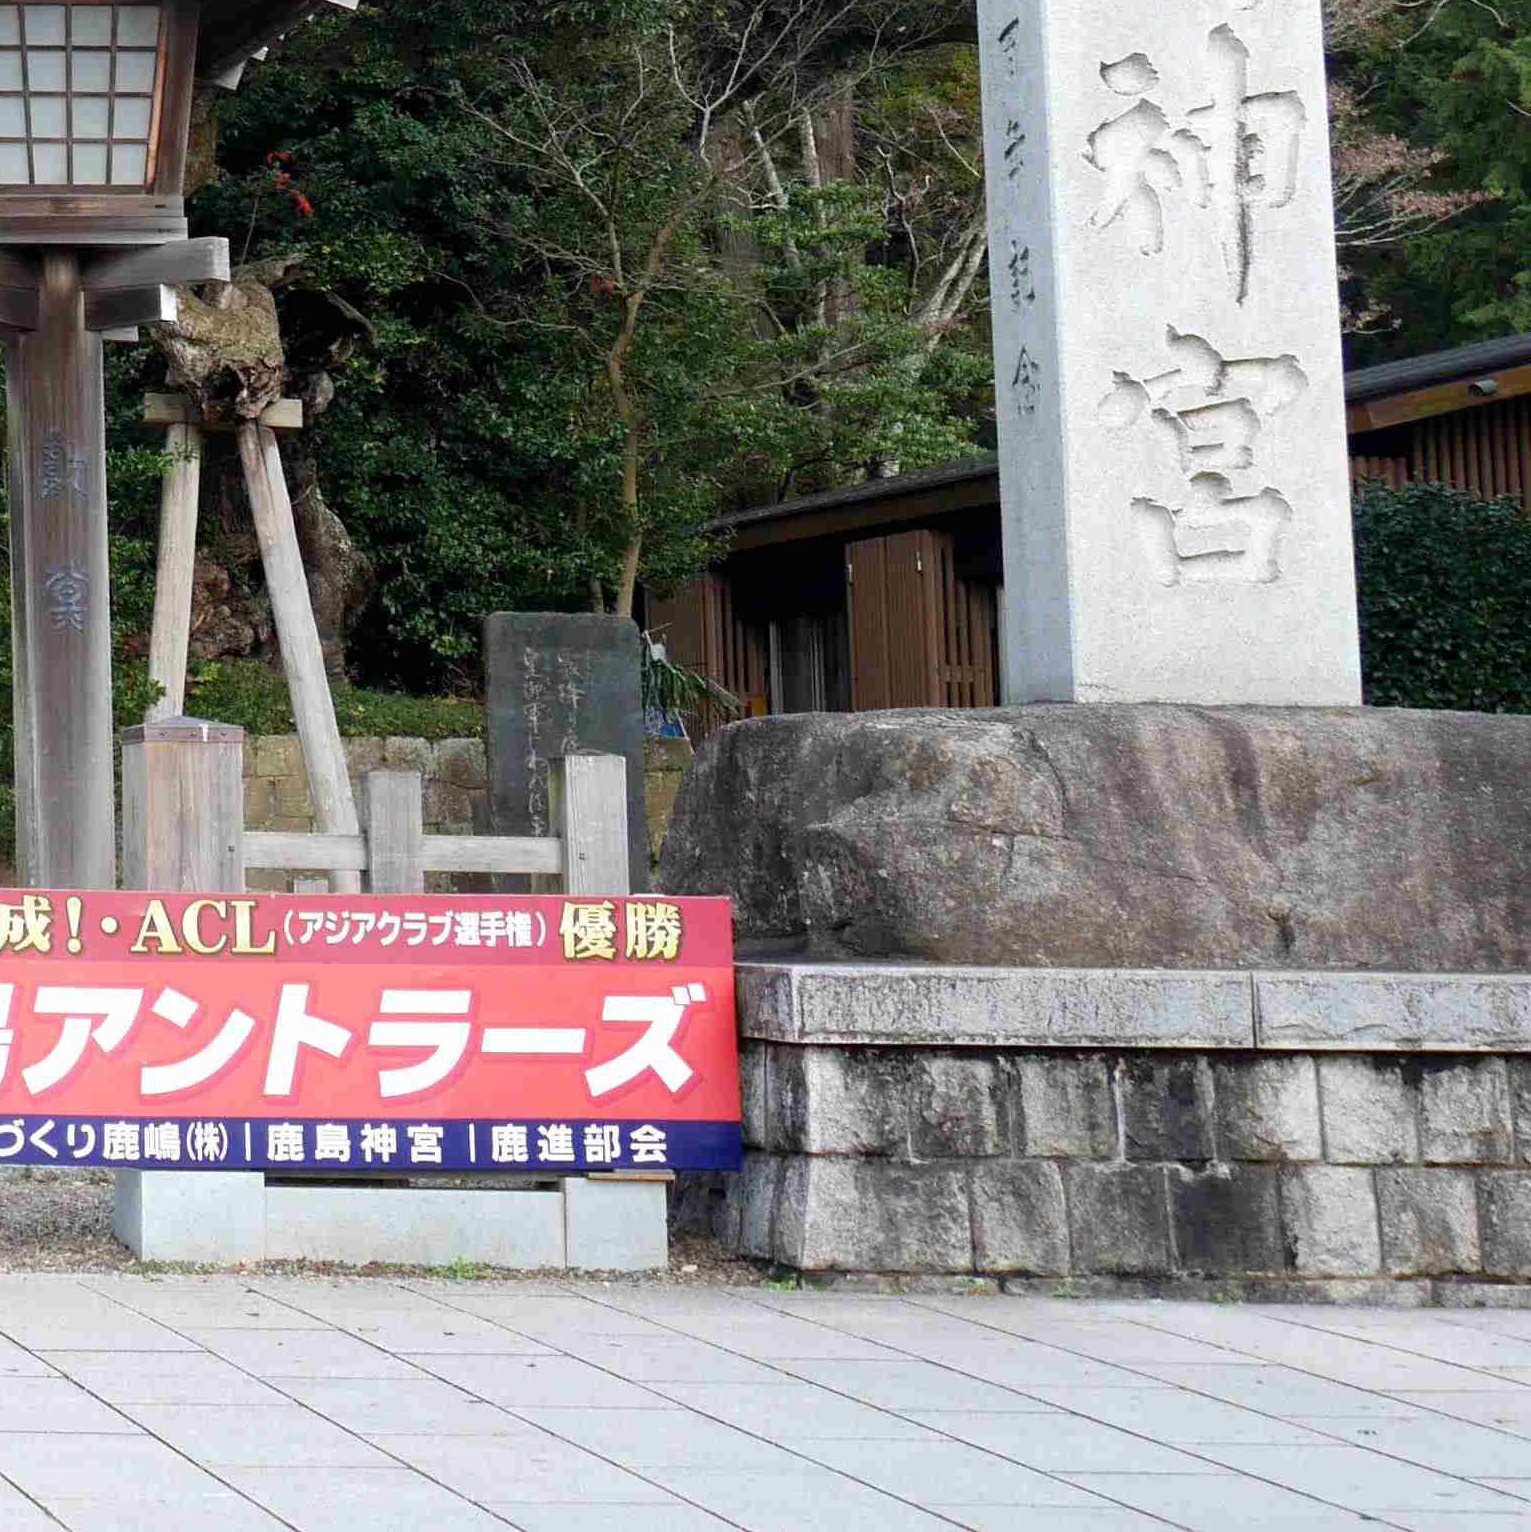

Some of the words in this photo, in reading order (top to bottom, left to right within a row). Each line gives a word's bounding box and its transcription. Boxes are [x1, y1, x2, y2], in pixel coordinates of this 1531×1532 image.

[266, 1124, 445, 1164] 鹿島神宮
[490, 1125, 669, 1165] 鹿進部会
